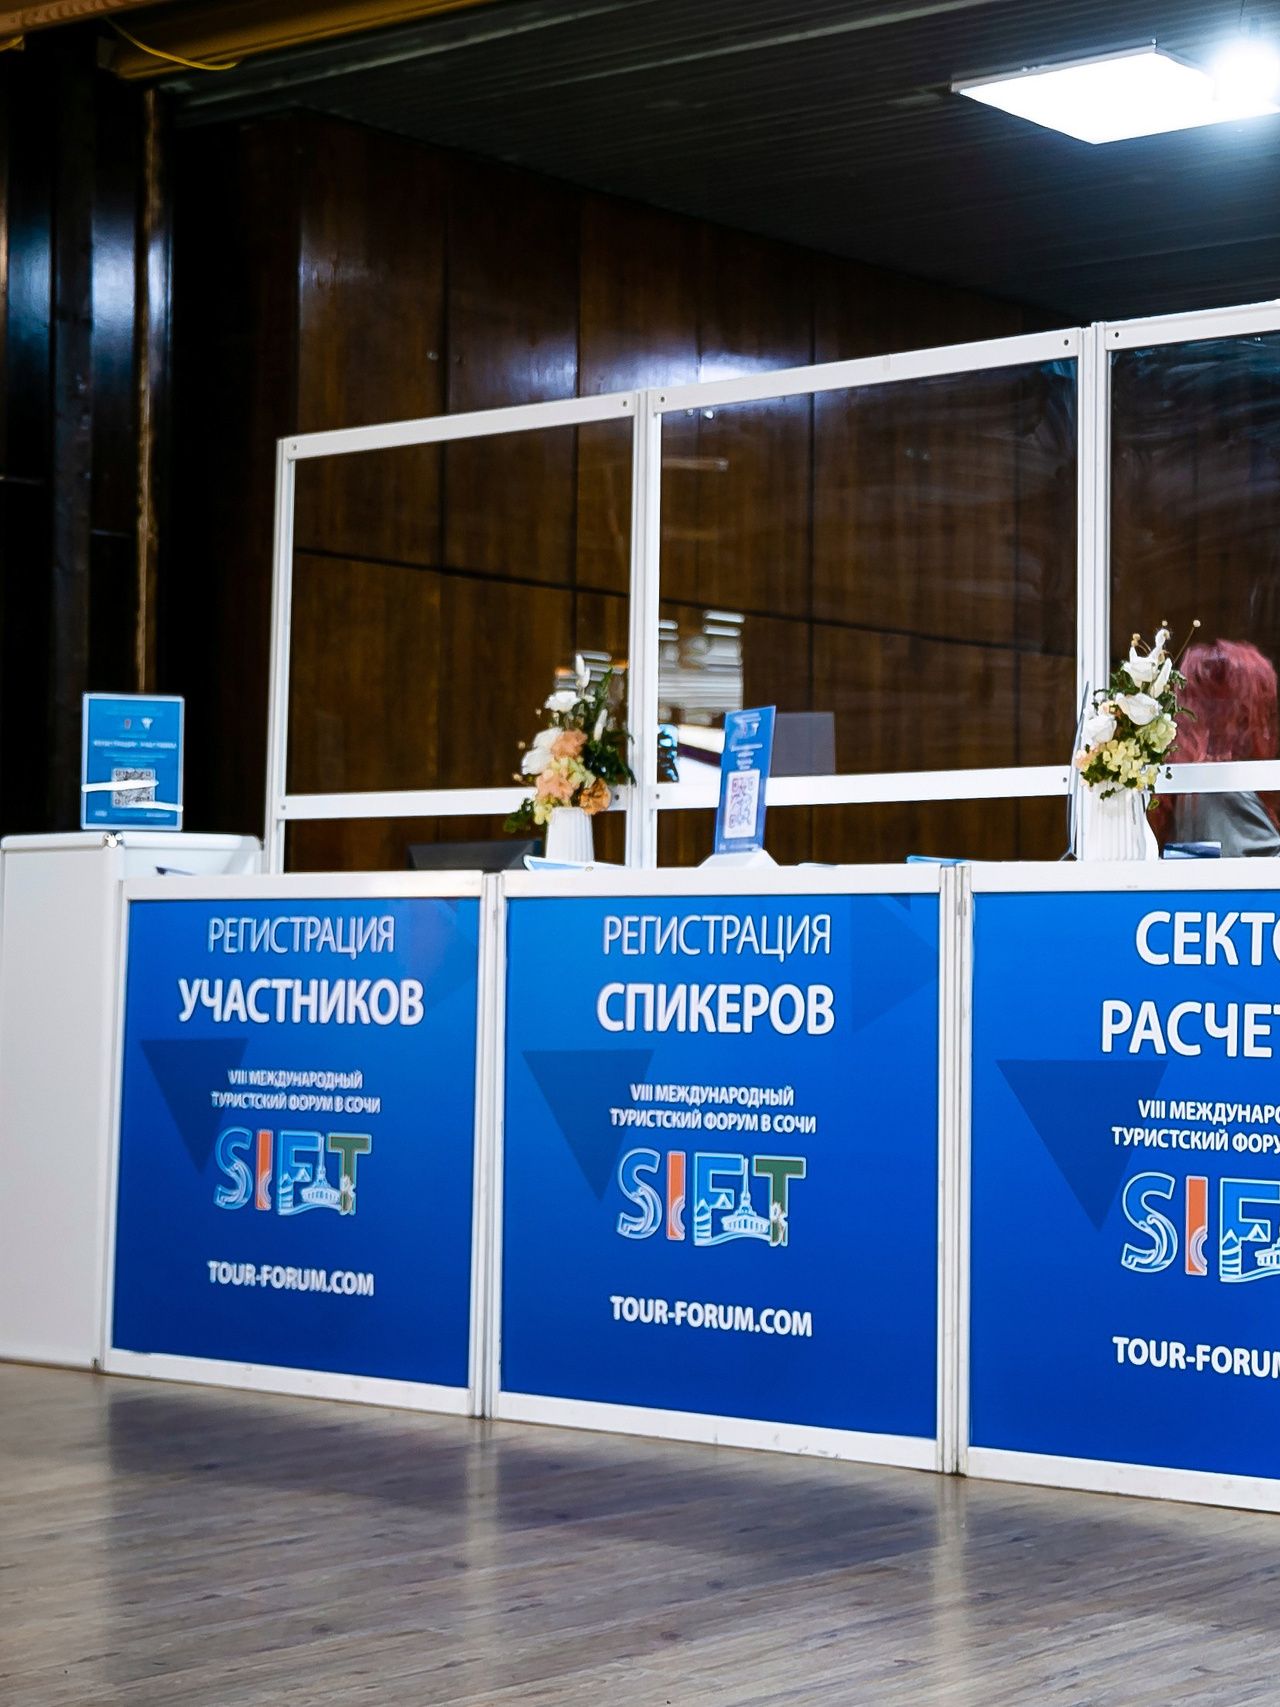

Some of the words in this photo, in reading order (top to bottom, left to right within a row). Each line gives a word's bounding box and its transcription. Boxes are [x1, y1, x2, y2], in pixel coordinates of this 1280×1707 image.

[207, 915, 396, 960] РЕГИСТРАЦИЯ
[602, 914, 832, 962] РЕГИСТРАЦИЯ
[178, 978, 425, 1026] УЧАСТНИКОВ
[597, 983, 836, 1035] СПИКЕРОВ
[228, 1069, 248, 1085] VIII
[249, 1069, 363, 1090] МЕЖДУНАРОДНЫЙ
[629, 1083, 653, 1101] VIII
[655, 1084, 794, 1108] МЕЖДУНАРОДНЫЙ
[210, 1090, 287, 1110] ТУРИСТСКИЙ
[287, 1093, 333, 1112] ФОРУМ
[334, 1095, 344, 1112] В
[344, 1096, 381, 1113] СОЧИ
[609, 1107, 702, 1129] ТУРИСТСКИЙ
[703, 1111, 759, 1131] ФОРУМ
[760, 1114, 771, 1132] В
[773, 1114, 816, 1133] СОЧИ
[1138, 1099, 1166, 1119] VIII
[1111, 1126, 1229, 1151] ТУРИСТСКИЙ
[213, 1126, 372, 1216] SIFT
[617, 1147, 806, 1246] SIFT
[207, 1259, 374, 1296] TOUR-FORUM.COM
[610, 1296, 813, 1337] TOUR-FORUM.COM
